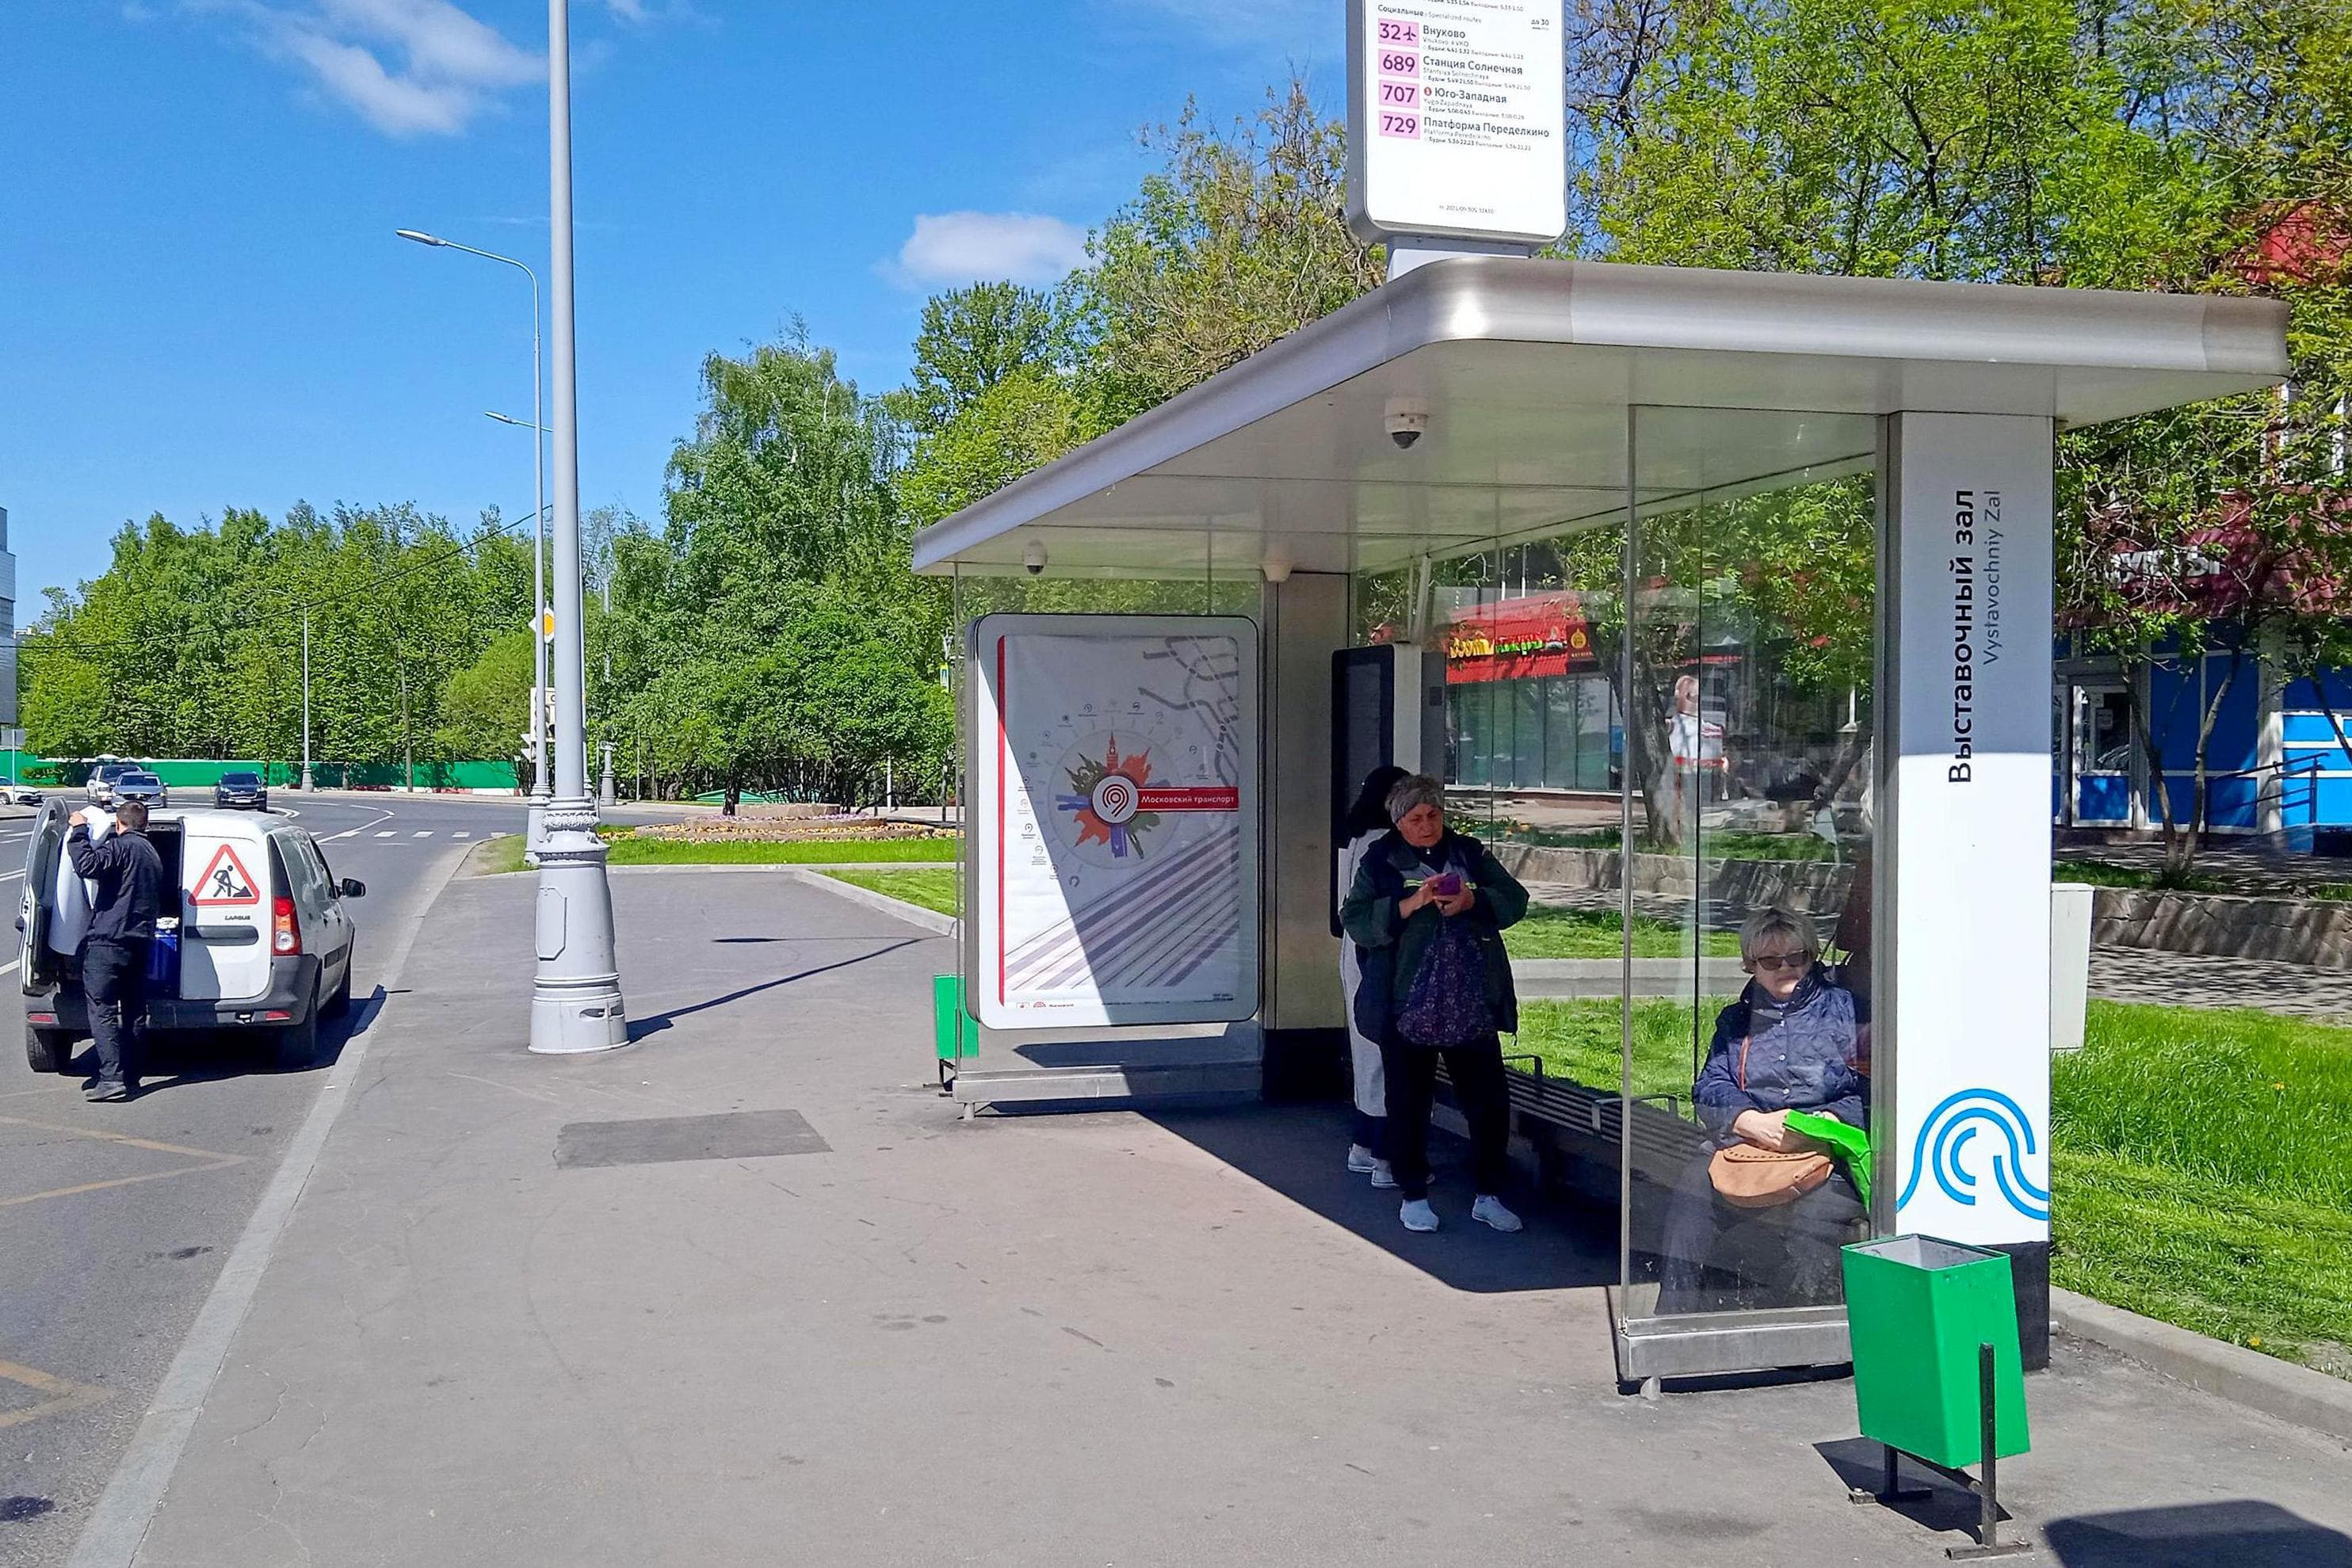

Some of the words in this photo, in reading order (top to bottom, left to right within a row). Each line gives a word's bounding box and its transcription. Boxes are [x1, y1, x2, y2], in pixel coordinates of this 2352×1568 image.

[1378, 4, 1424, 17] Социальные
[1380, 22, 1401, 40] 32
[1422, 25, 1466, 38] Внуково
[1383, 54, 1415, 73] 689
[1422, 56, 1465, 69] Станция
[1468, 60, 1522, 75] Солнечная
[1383, 84, 1415, 103] 707
[1434, 87, 1507, 103] Юго-Западная
[1384, 115, 1416, 134] 729
[1424, 116, 1480, 132] Платформа
[1483, 122, 1550, 138] Переделкино
[1983, 489, 2002, 522] Zal
[1955, 489, 1974, 547] зал
[1983, 527, 2005, 666] Vystavochniy
[1949, 557, 1974, 783] Выставочный
[1140, 795, 1193, 803] Московский
[1193, 795, 1235, 804] транспорт
